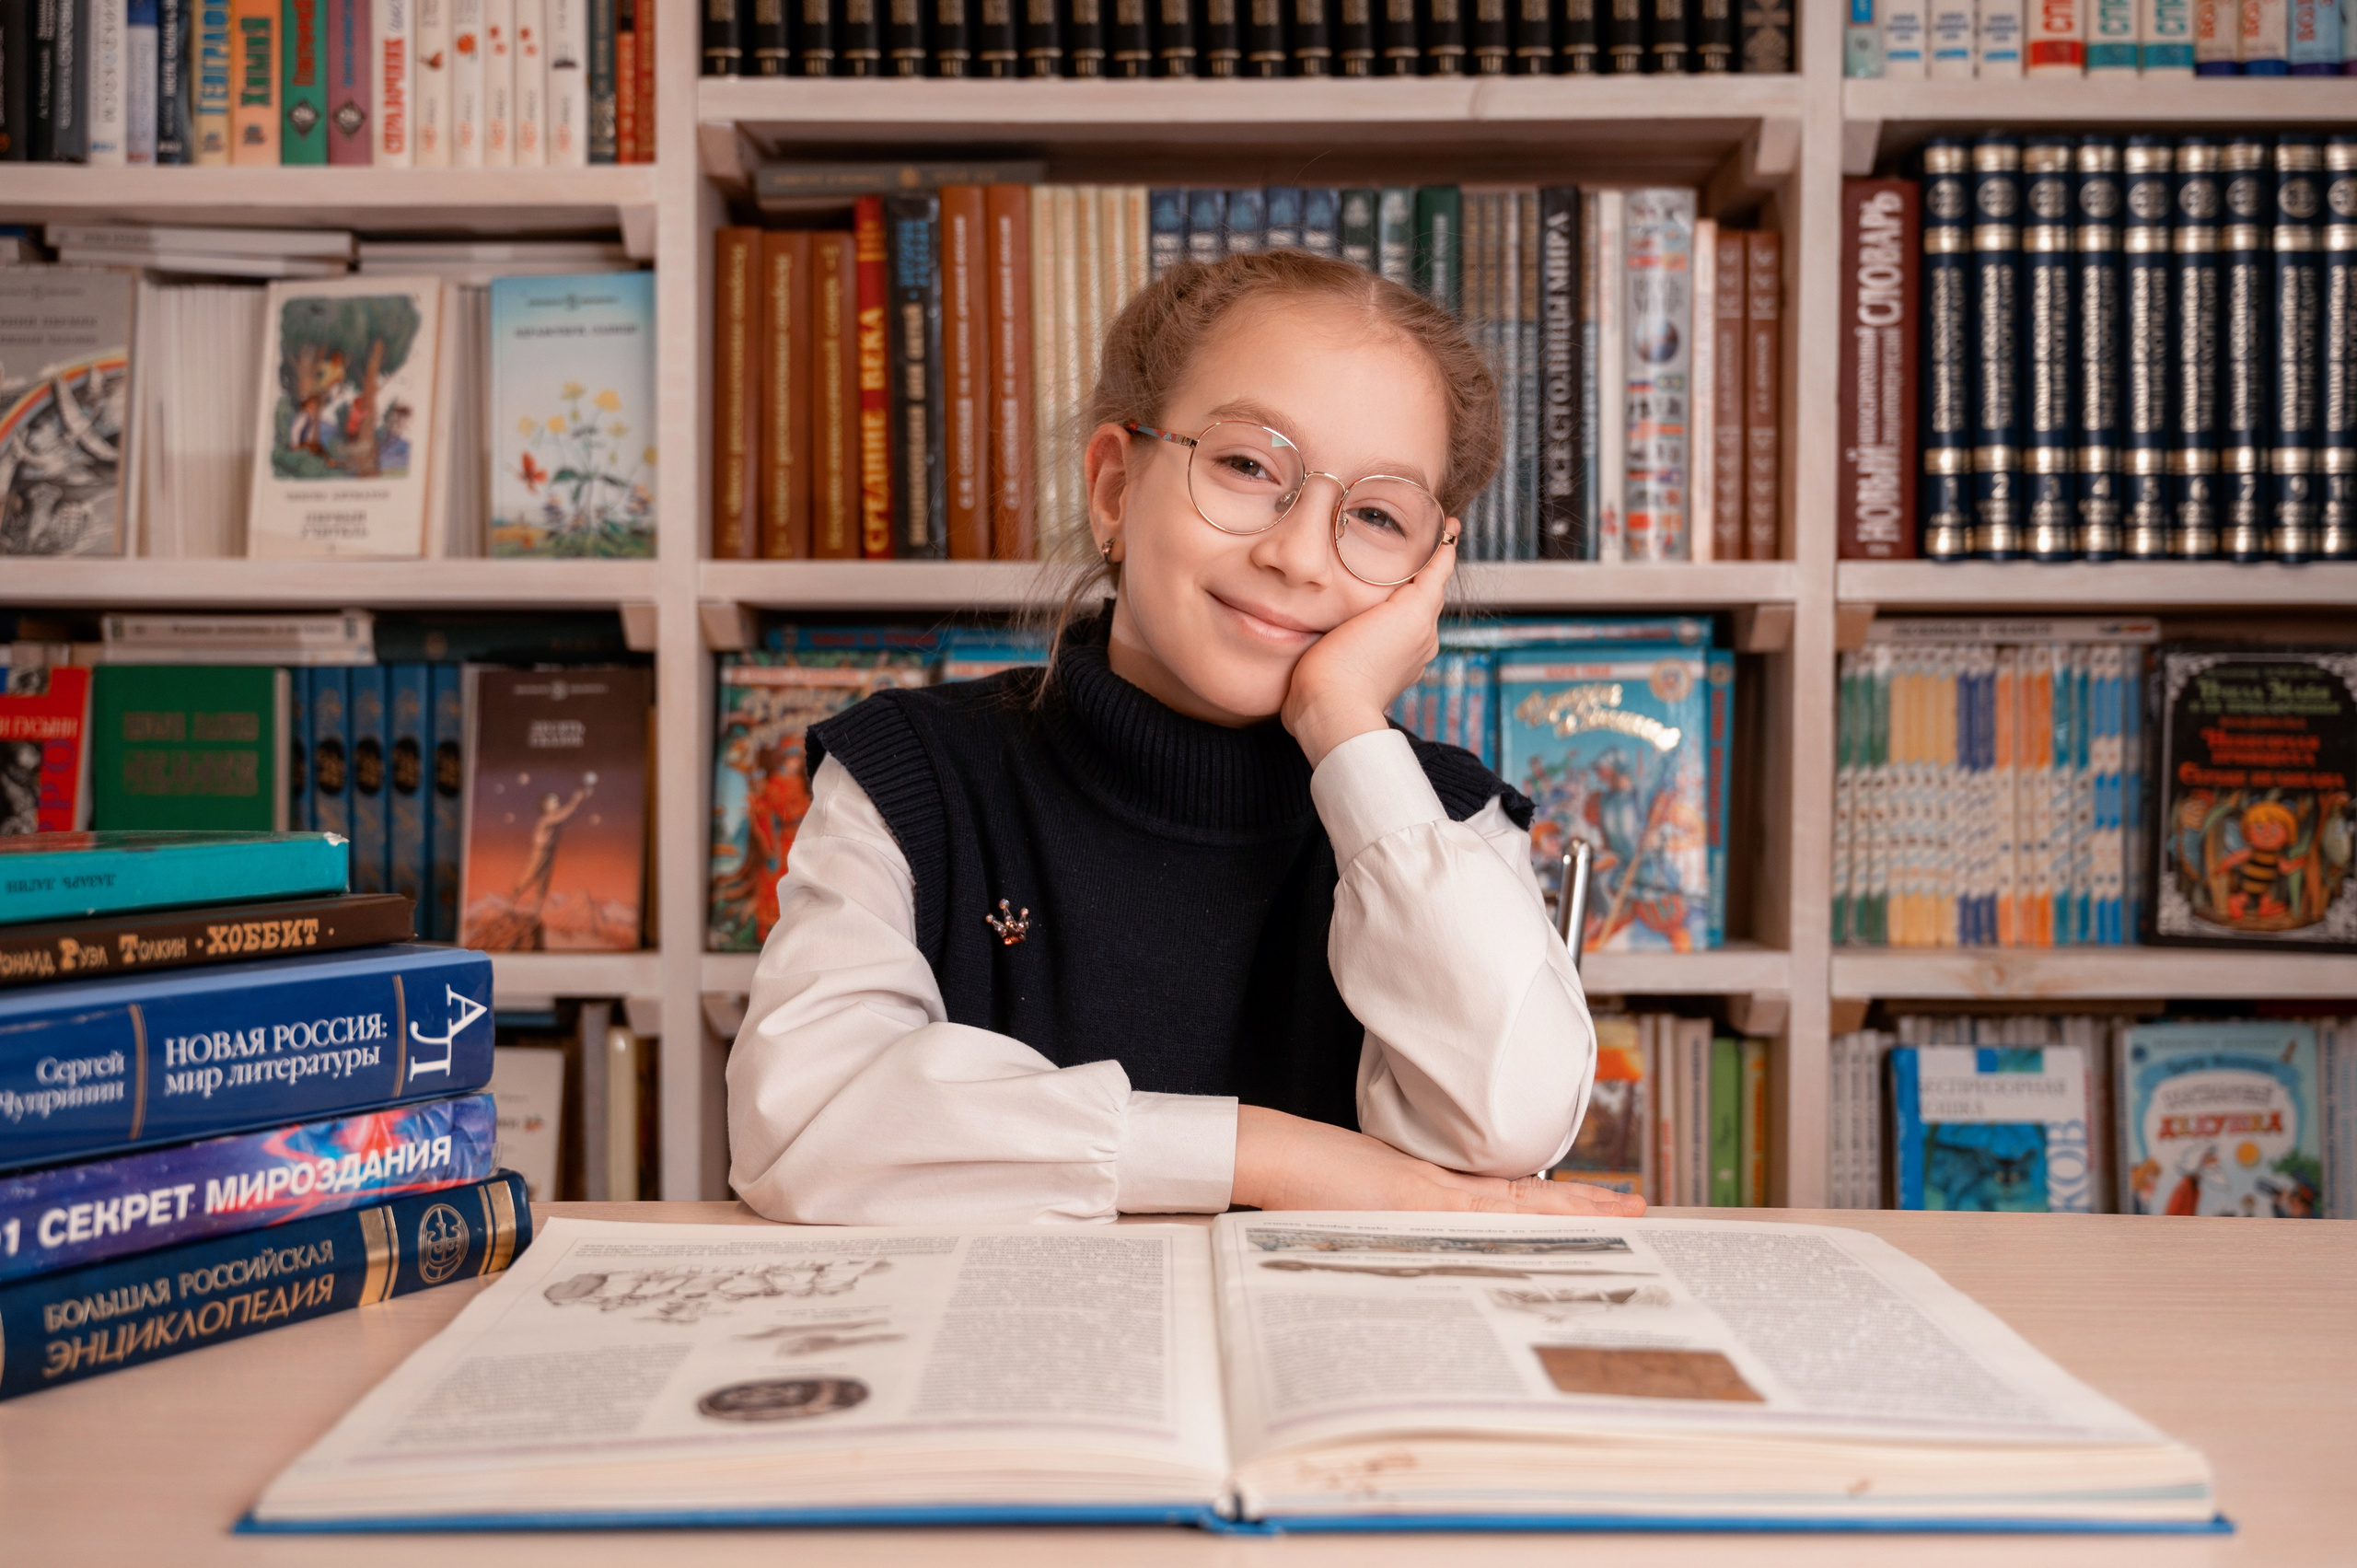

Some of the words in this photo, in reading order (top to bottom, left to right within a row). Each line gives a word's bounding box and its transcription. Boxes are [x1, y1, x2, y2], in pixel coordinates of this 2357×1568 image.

[1545, 211, 1571, 292] МИРА
[1857, 190, 1904, 327] СЛОВАРЬ
[859, 307, 887, 391] ВЕКА
[1991, 471, 2011, 500] 2
[0, 949, 56, 978] ОНАЛД
[206, 918, 319, 956] ХОББИТ
[35, 1049, 125, 1088] Сергей
[162, 1065, 224, 1099] мир
[226, 1045, 381, 1086] литературы
[164, 1026, 267, 1068] НОВАЯ
[273, 1012, 388, 1052] РОССИЯ:
[37, 1183, 196, 1249] СЕКРЕТ
[203, 1134, 453, 1214] МИРОЗДАНИЯ
[41, 1272, 336, 1379] ЭНЦИКЛОПЕДИЯ
[42, 1276, 172, 1334] БОЛЬШАЯ
[177, 1238, 335, 1298] РОССИЙСКАЯ
